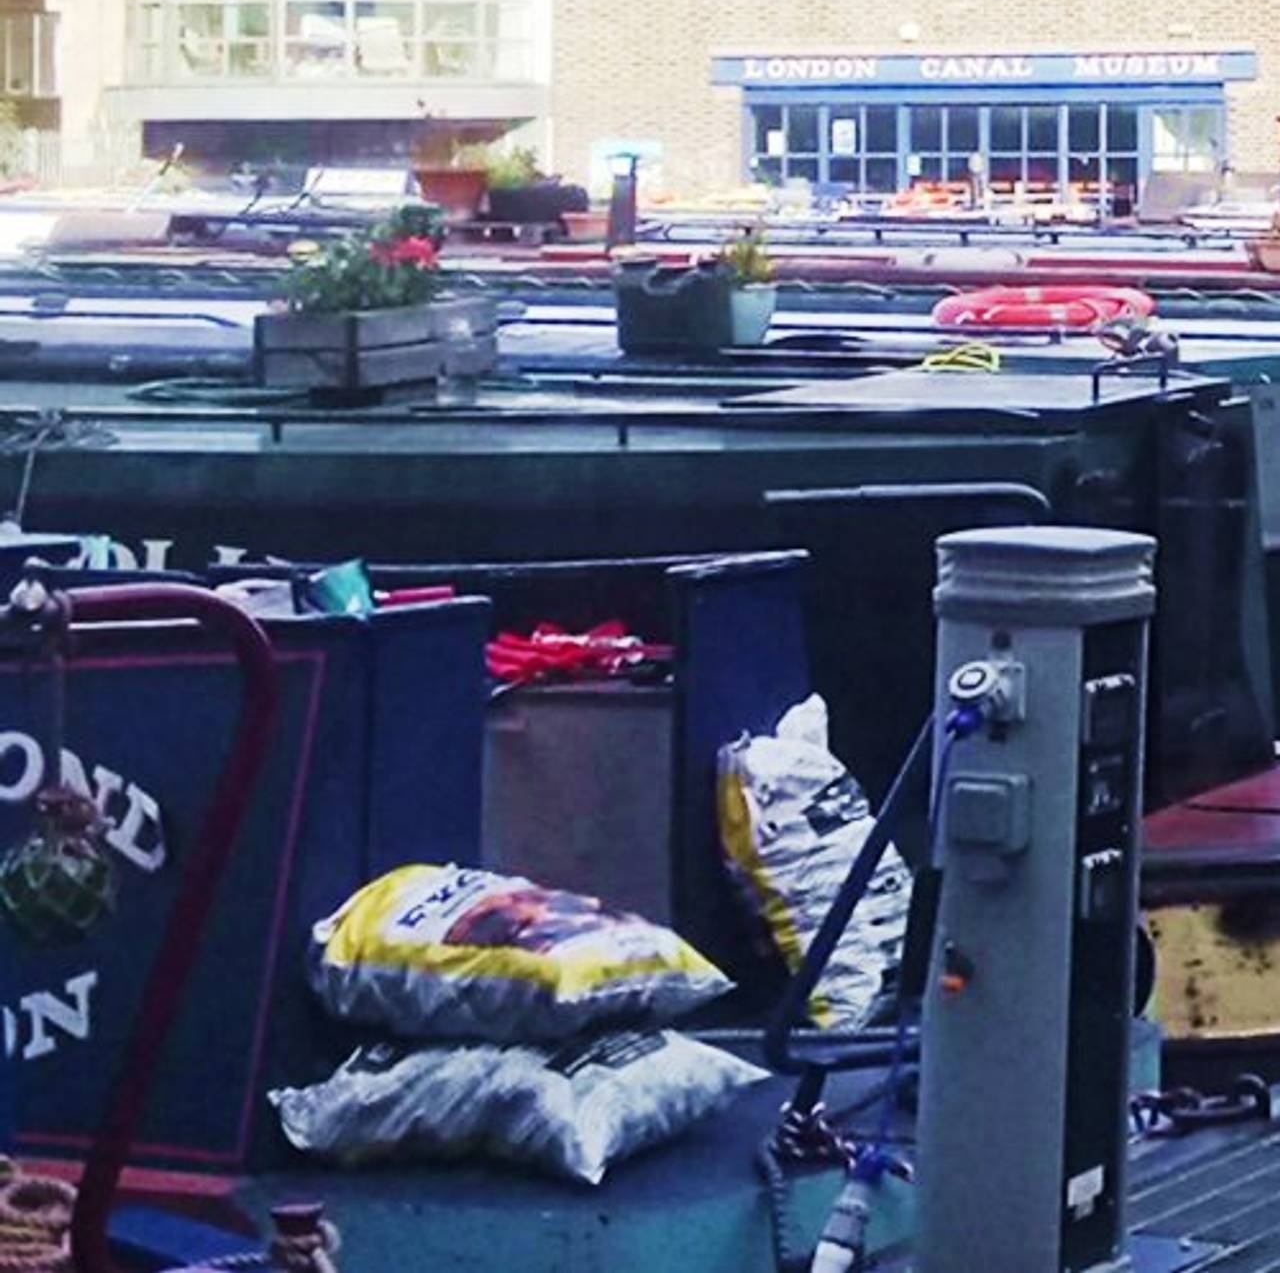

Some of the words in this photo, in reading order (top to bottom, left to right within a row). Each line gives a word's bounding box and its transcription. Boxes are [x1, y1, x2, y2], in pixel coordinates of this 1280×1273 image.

[744, 59, 877, 78] LONDON
[920, 58, 1034, 77] CANAL
[1073, 55, 1221, 76] MUSEUM
